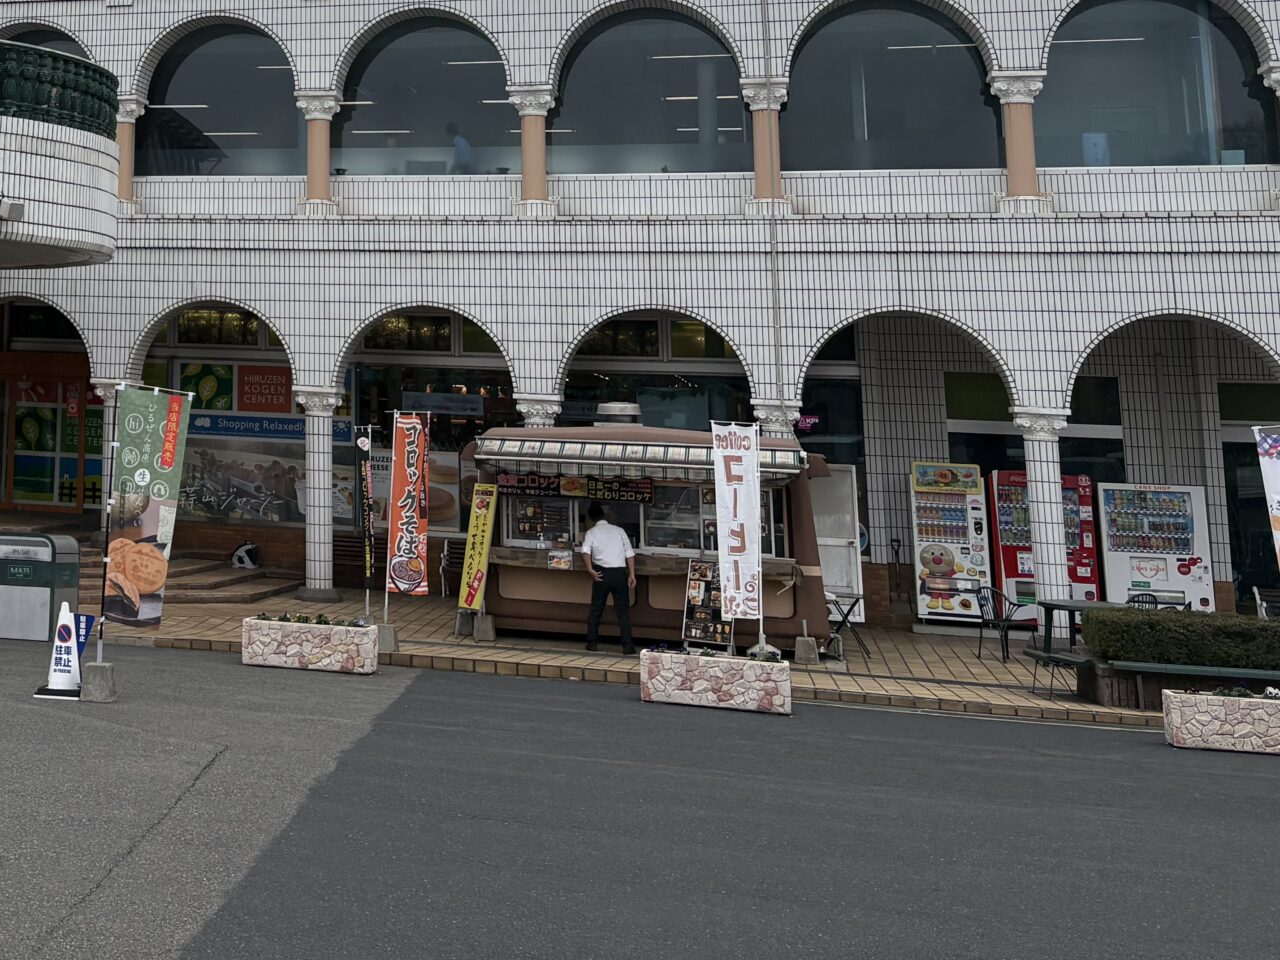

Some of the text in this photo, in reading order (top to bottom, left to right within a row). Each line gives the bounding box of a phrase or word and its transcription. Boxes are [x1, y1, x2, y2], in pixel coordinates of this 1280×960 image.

[244, 374, 286, 384] HIRUZEN
[244, 384, 286, 394] KOGEN
[243, 394, 286, 405] CENTER
[129, 417, 139, 430] hi
[217, 417, 260, 431] Shopping
[163, 402, 181, 462] 当店限定販売
[588, 480, 619, 490] 日本一の
[588, 489, 651, 502] こだわりコロッケ
[55, 644, 72, 656] 駐車
[54, 656, 72, 668] 禁止
